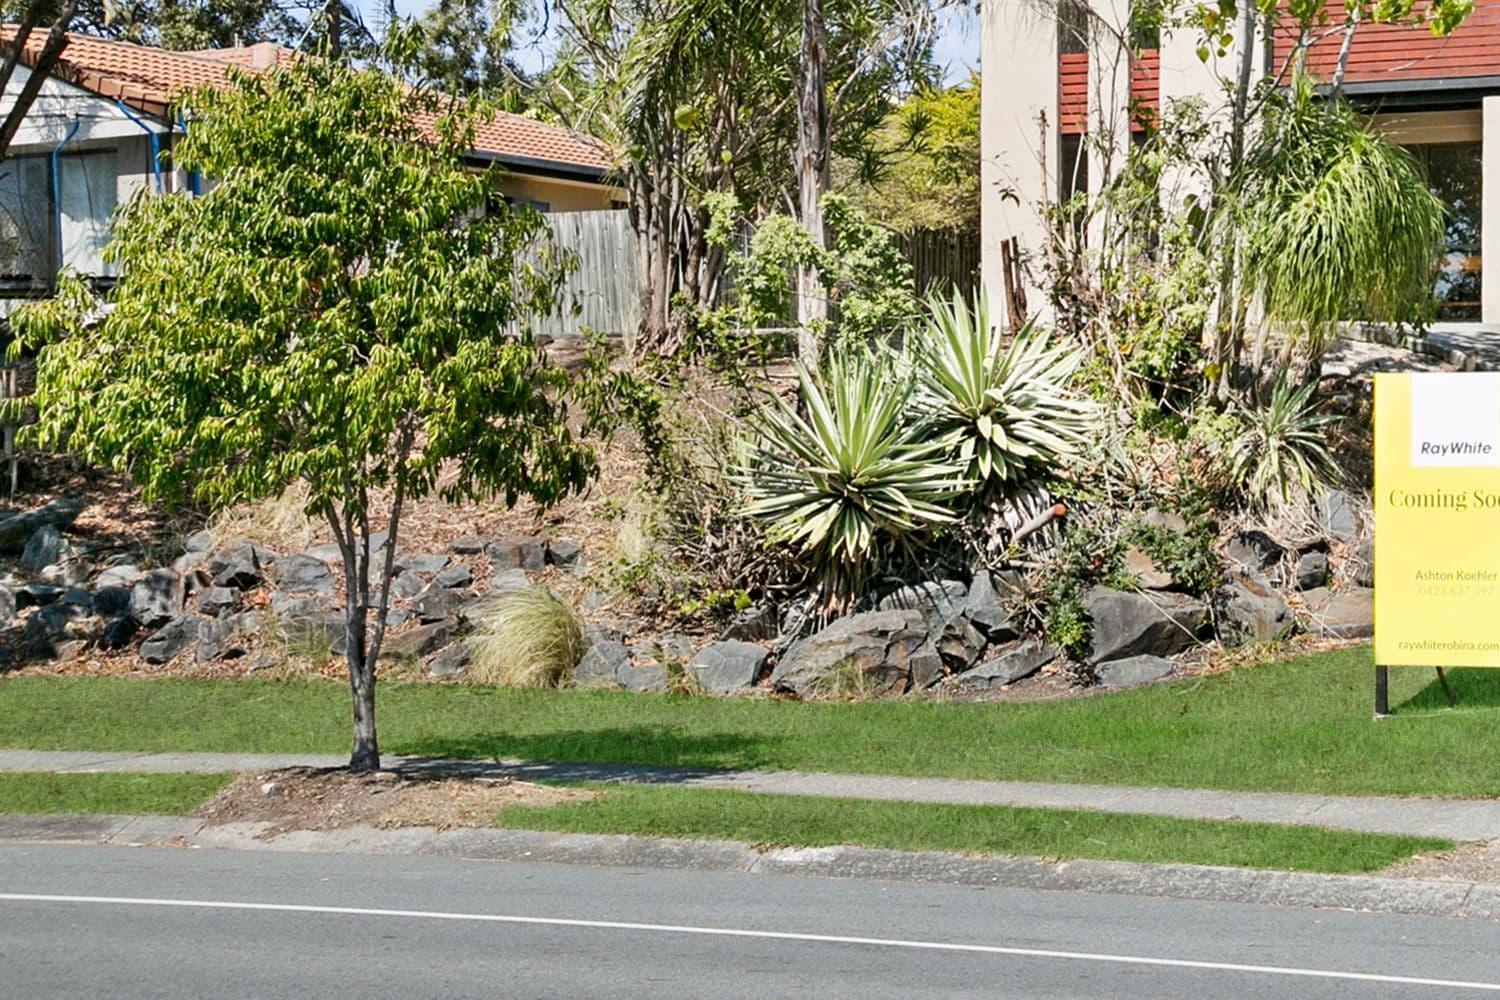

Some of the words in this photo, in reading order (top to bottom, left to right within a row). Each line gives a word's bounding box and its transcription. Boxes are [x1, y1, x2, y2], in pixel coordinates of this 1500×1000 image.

[1389, 488, 1468, 512] Coming
[1415, 569, 1453, 581] Ashton
[1456, 569, 1498, 582] Koehler
